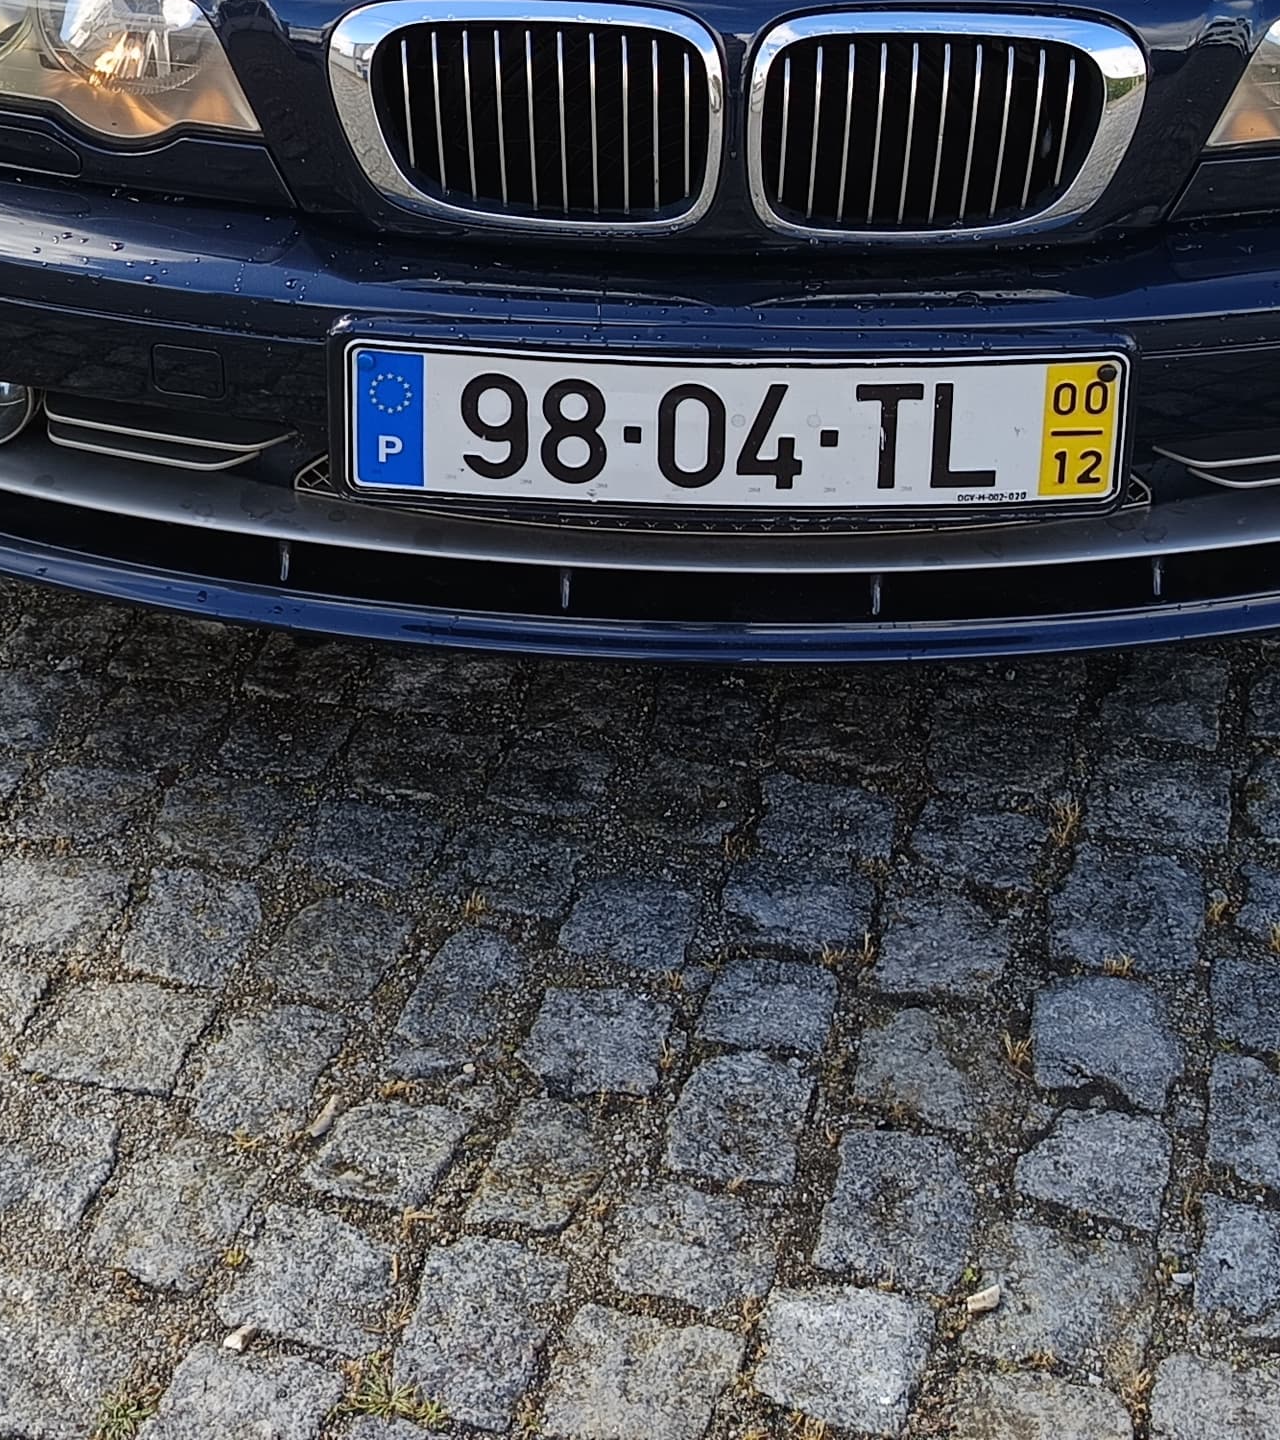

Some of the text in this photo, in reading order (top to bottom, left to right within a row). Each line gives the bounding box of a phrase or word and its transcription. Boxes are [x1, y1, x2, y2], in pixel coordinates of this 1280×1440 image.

[1053, 381, 1108, 416] 00
[378, 435, 403, 463] P
[1054, 450, 1102, 484] 12
